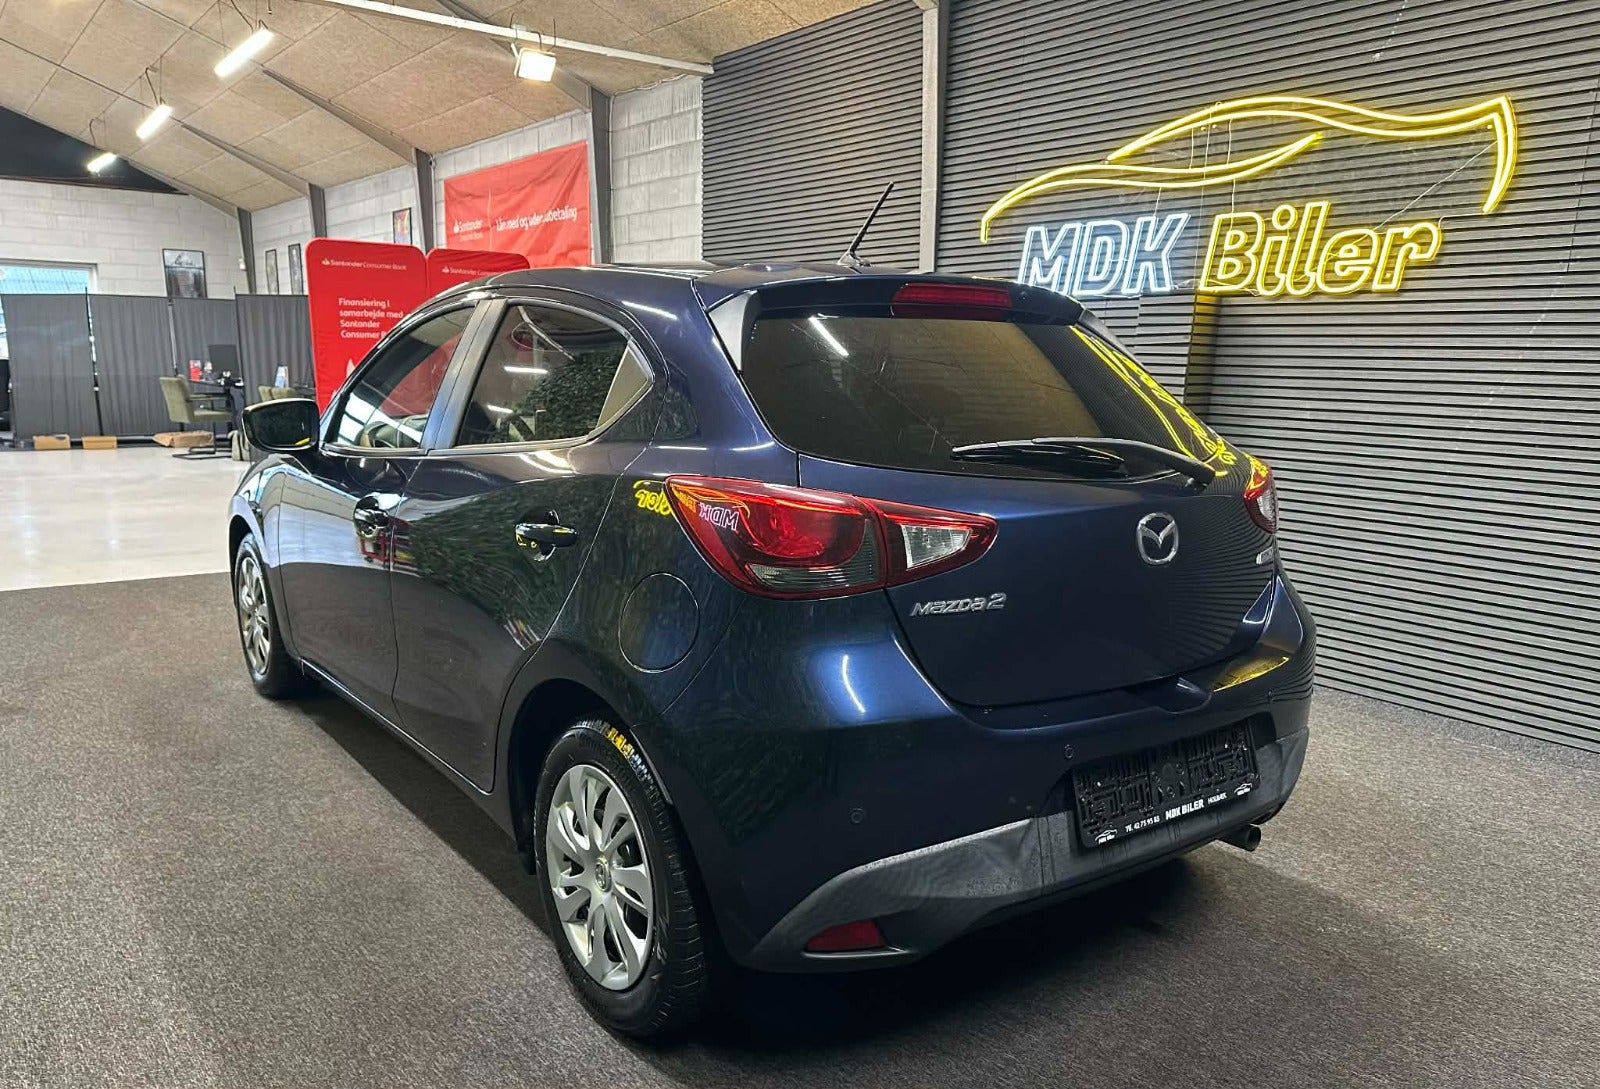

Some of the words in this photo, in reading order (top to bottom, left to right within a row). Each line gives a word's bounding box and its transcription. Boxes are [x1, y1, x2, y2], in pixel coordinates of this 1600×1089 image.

[1017, 212, 1191, 296] MDK
[1199, 200, 1443, 297] Biler
[331, 259, 362, 268] Santander
[338, 298, 386, 309] Finansiering
[339, 309, 385, 319] samarbejde
[386, 310, 404, 318] med
[340, 319, 380, 328] Santander
[340, 330, 379, 339] Consumer
[1181, 799, 1204, 815] BILER
